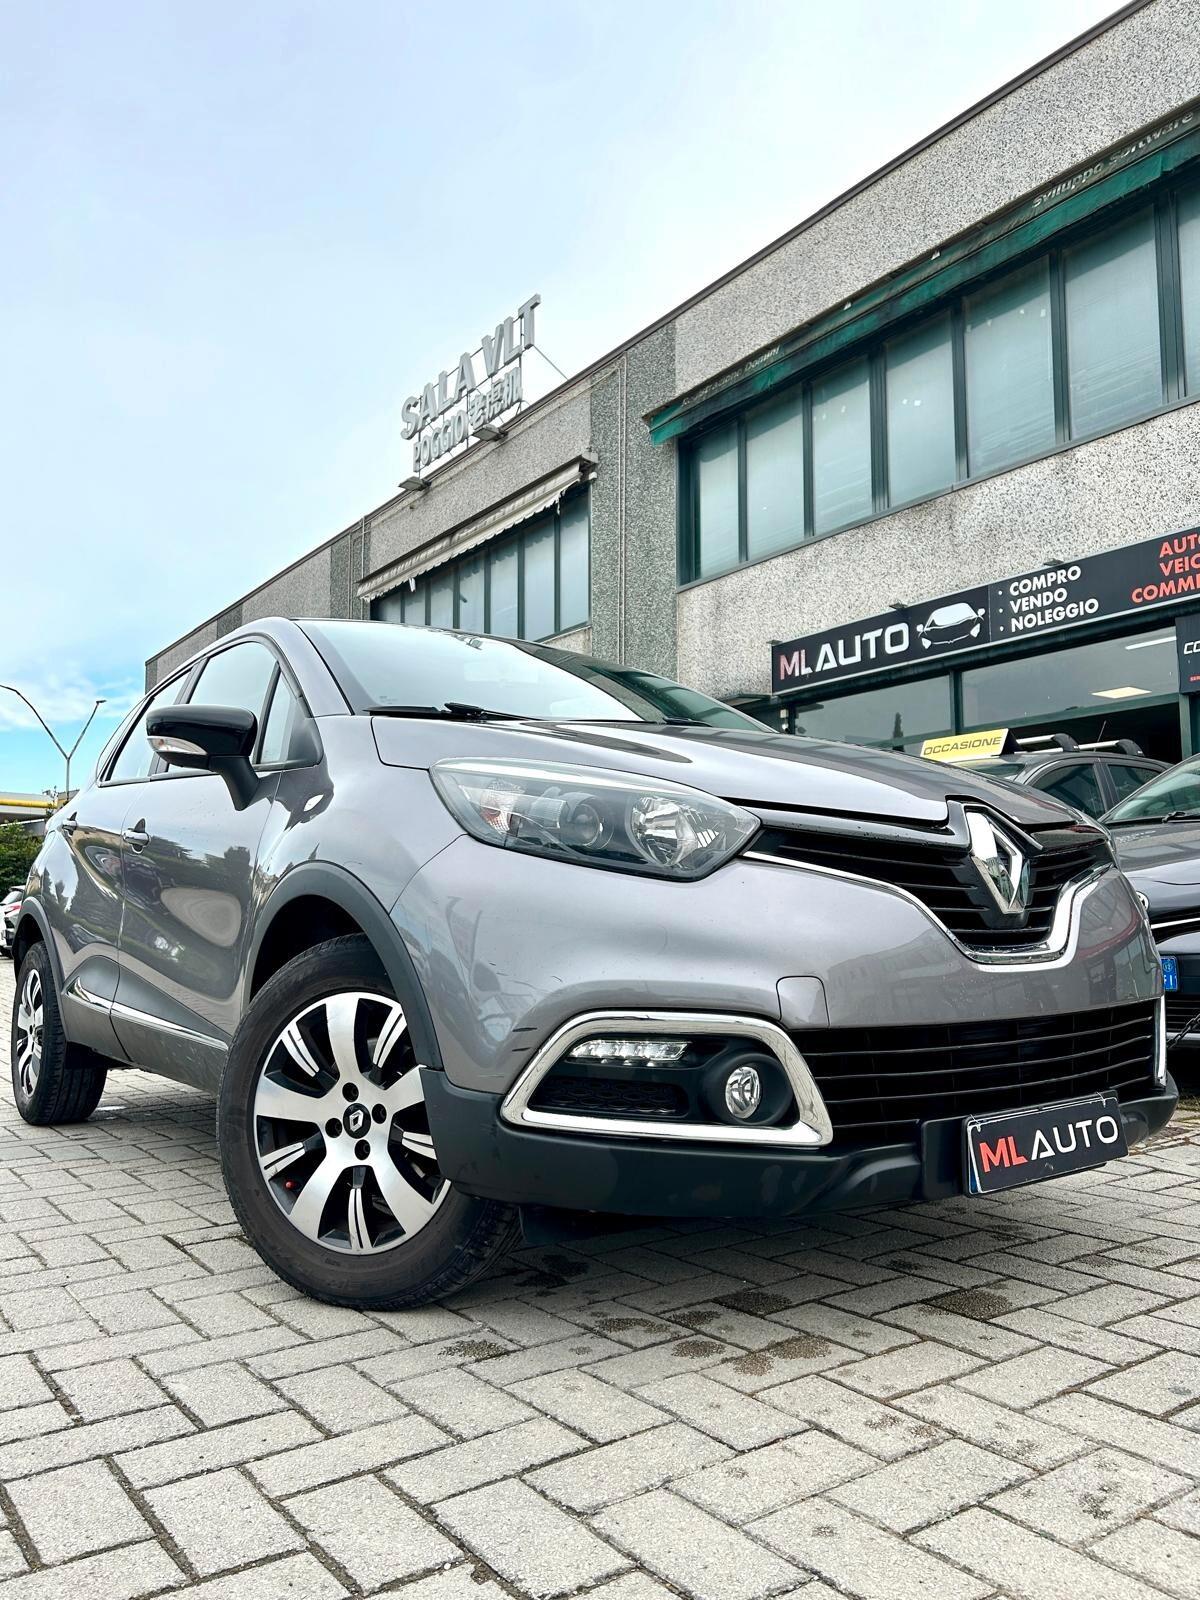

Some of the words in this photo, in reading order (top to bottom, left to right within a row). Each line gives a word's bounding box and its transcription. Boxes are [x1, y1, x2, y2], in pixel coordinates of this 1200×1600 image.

[401, 352, 475, 440] SALA
[481, 294, 541, 377] VLT
[413, 410, 468, 473] POGGIO
[1009, 565, 1081, 597] COMPRO
[1010, 587, 1067, 613] VENDO
[1011, 598, 1099, 632] NOLEGGIO
[815, 622, 910, 672] AUTO
[923, 736, 1002, 757] OCCASIONE
[979, 1135, 1028, 1173] ML
[1031, 1115, 1119, 1160] AUTO
